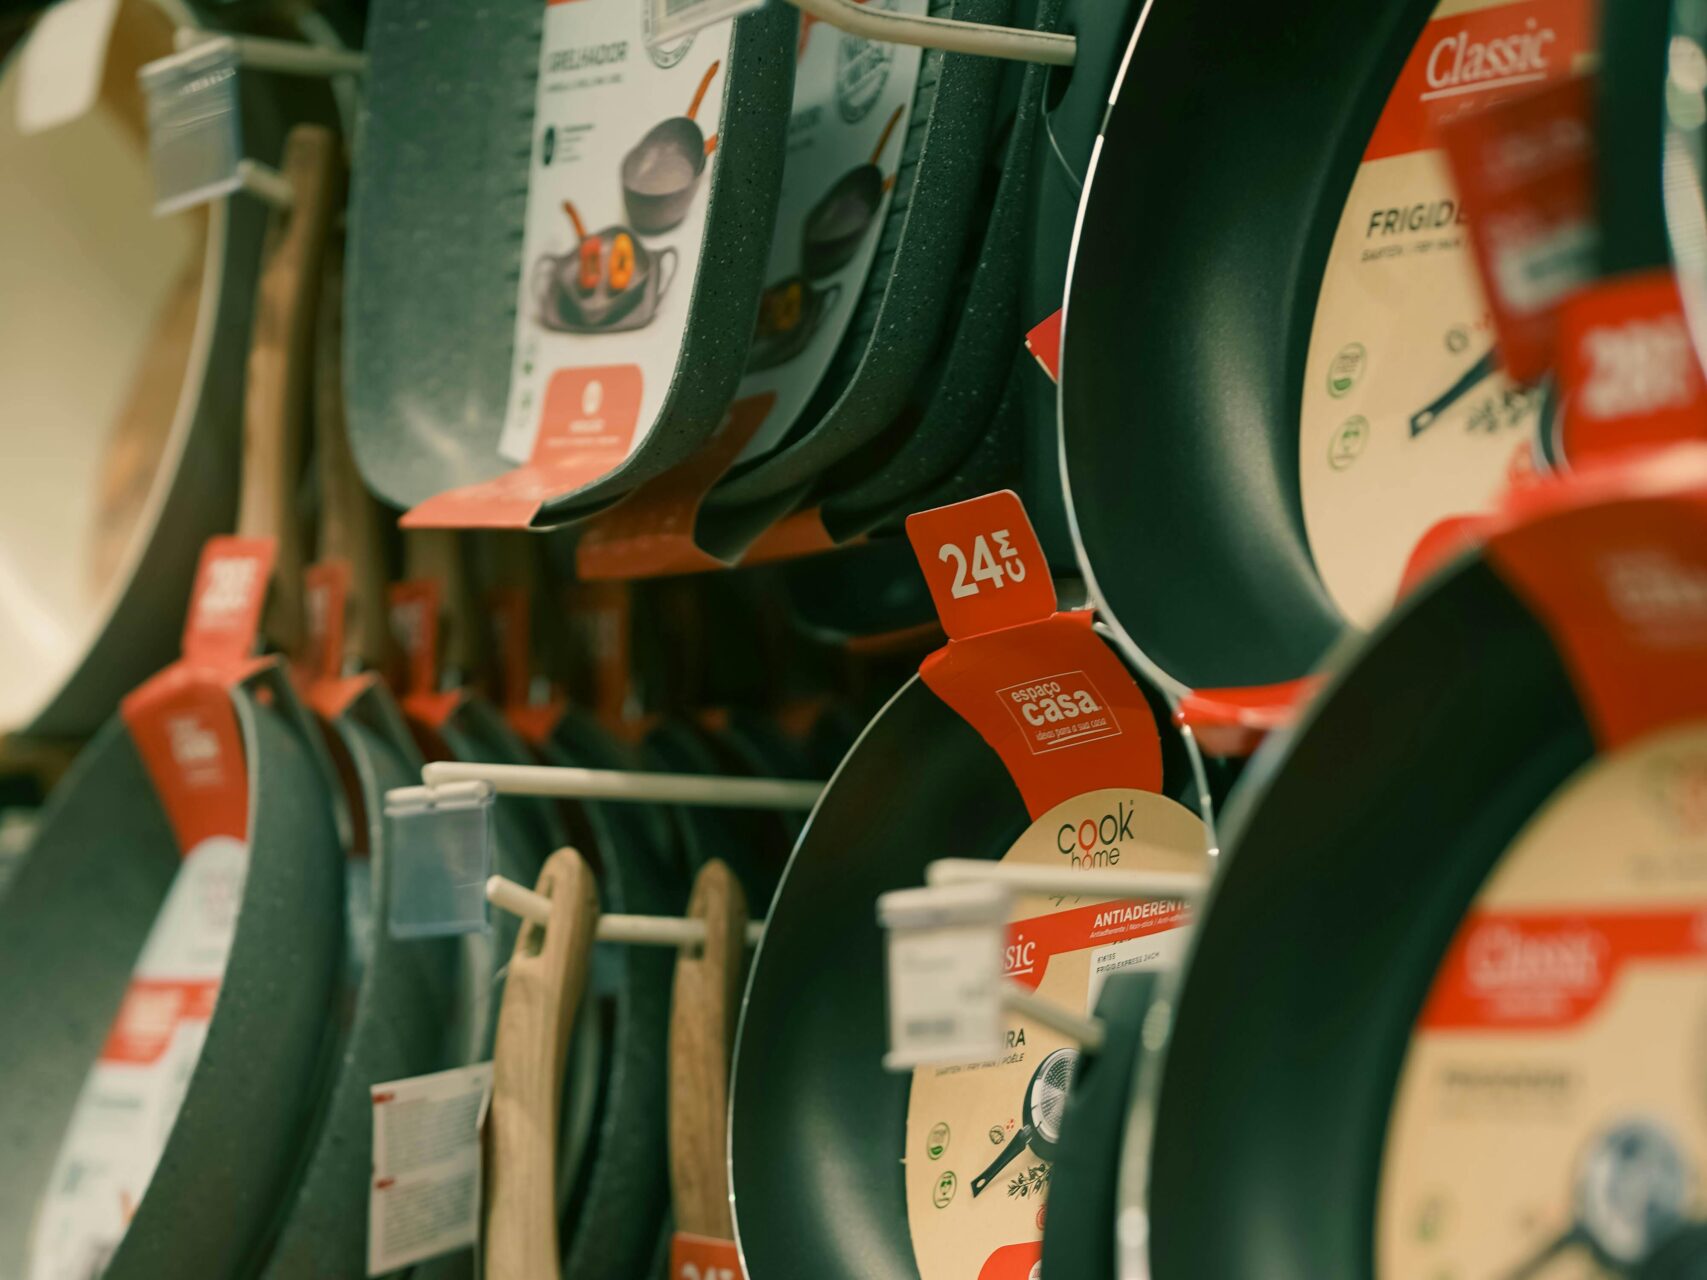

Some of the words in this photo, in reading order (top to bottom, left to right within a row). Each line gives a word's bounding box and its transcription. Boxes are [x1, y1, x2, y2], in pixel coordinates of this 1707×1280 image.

[1426, 17, 1556, 89] Classic
[1011, 681, 1061, 703] espaço
[1022, 690, 1100, 727] casa
[1057, 801, 1135, 855] cook
